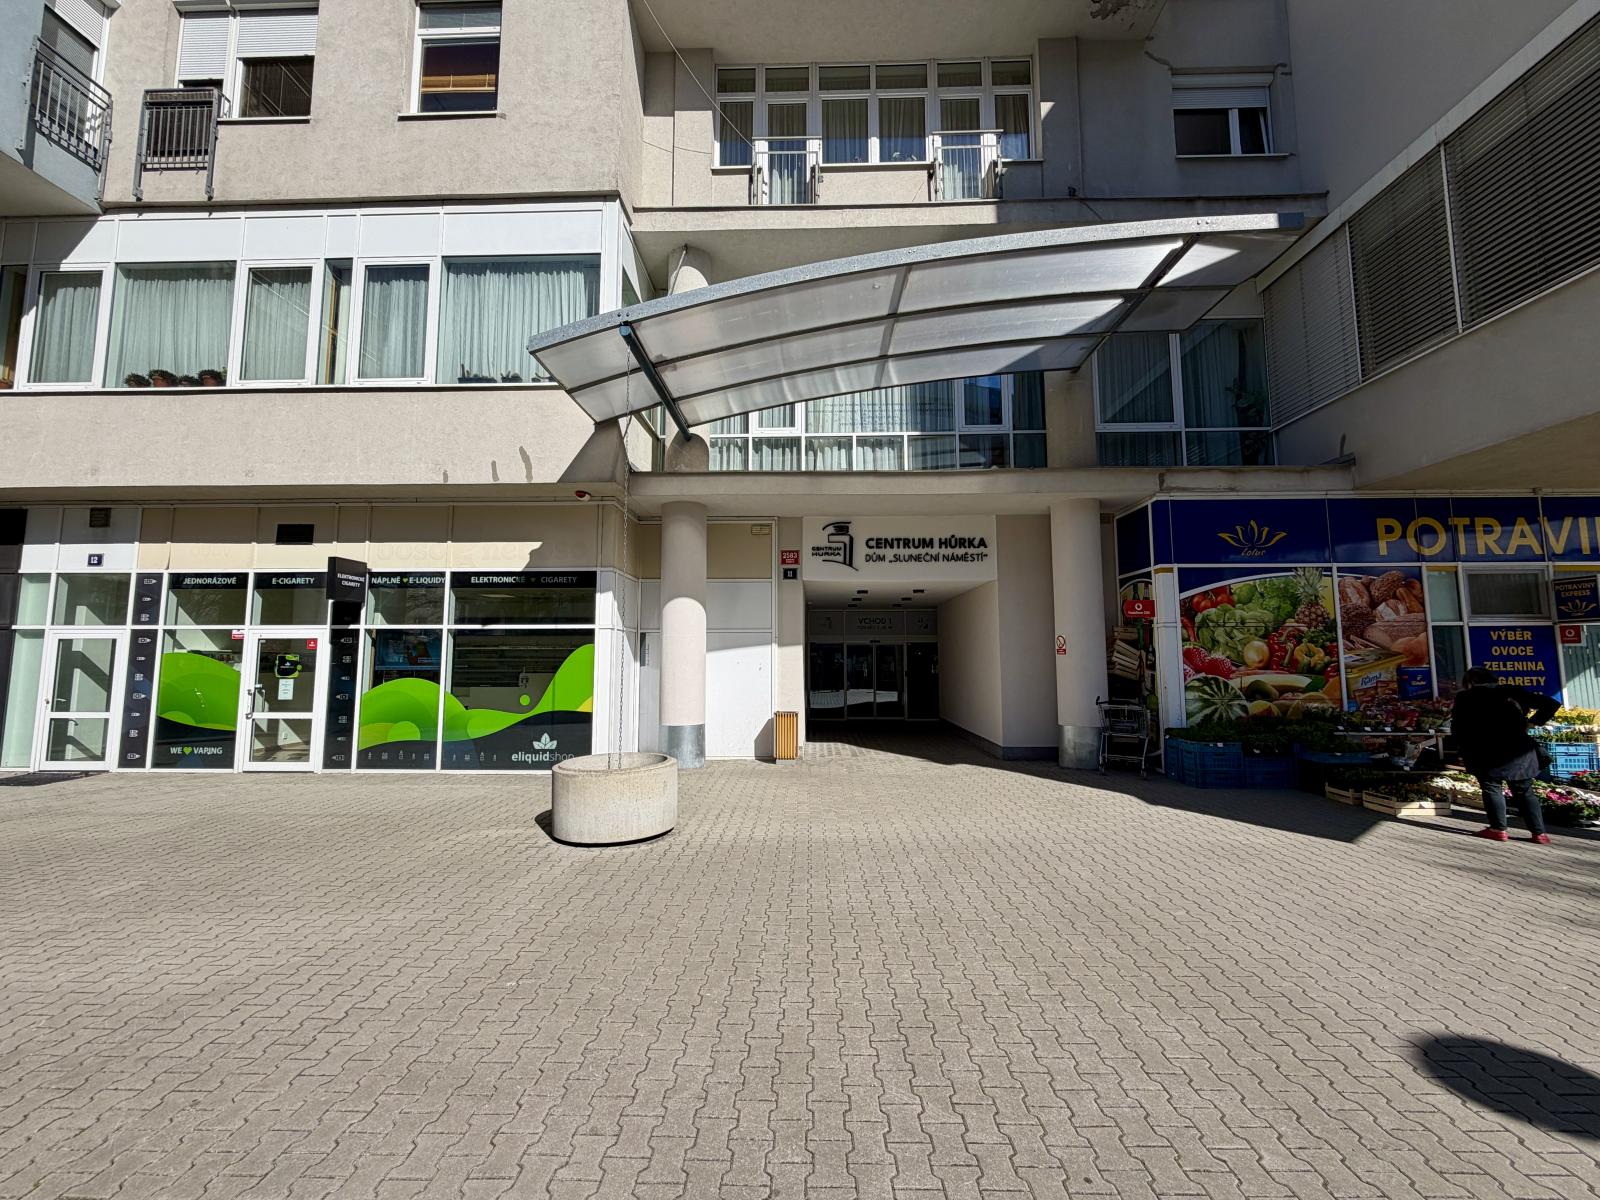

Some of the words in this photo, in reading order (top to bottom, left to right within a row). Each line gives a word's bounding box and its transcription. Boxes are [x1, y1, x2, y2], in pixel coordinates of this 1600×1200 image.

[1376, 516, 1600, 556] POTRAVI
[865, 536, 934, 550] CENTRUM
[938, 534, 988, 549] HŮRKA
[90, 556, 98, 564] 12
[865, 552, 886, 562] DŮM
[183, 576, 237, 585] JEDNORÁZOVÉ
[272, 576, 315, 584] E-CIGARETY
[409, 576, 446, 585] E-LIQUIDY
[471, 575, 526, 583] ELEKTRONICKÉ
[1555, 582, 1595, 591] POTRAVINY
[1561, 590, 1591, 598] EXPRESS
[1490, 629, 1532, 641] VÝBĚR
[1491, 646, 1534, 656] OVOCE
[1484, 661, 1545, 671] ZELENINA
[1498, 676, 1546, 686] GARETY
[193, 747, 223, 755] VAPING
